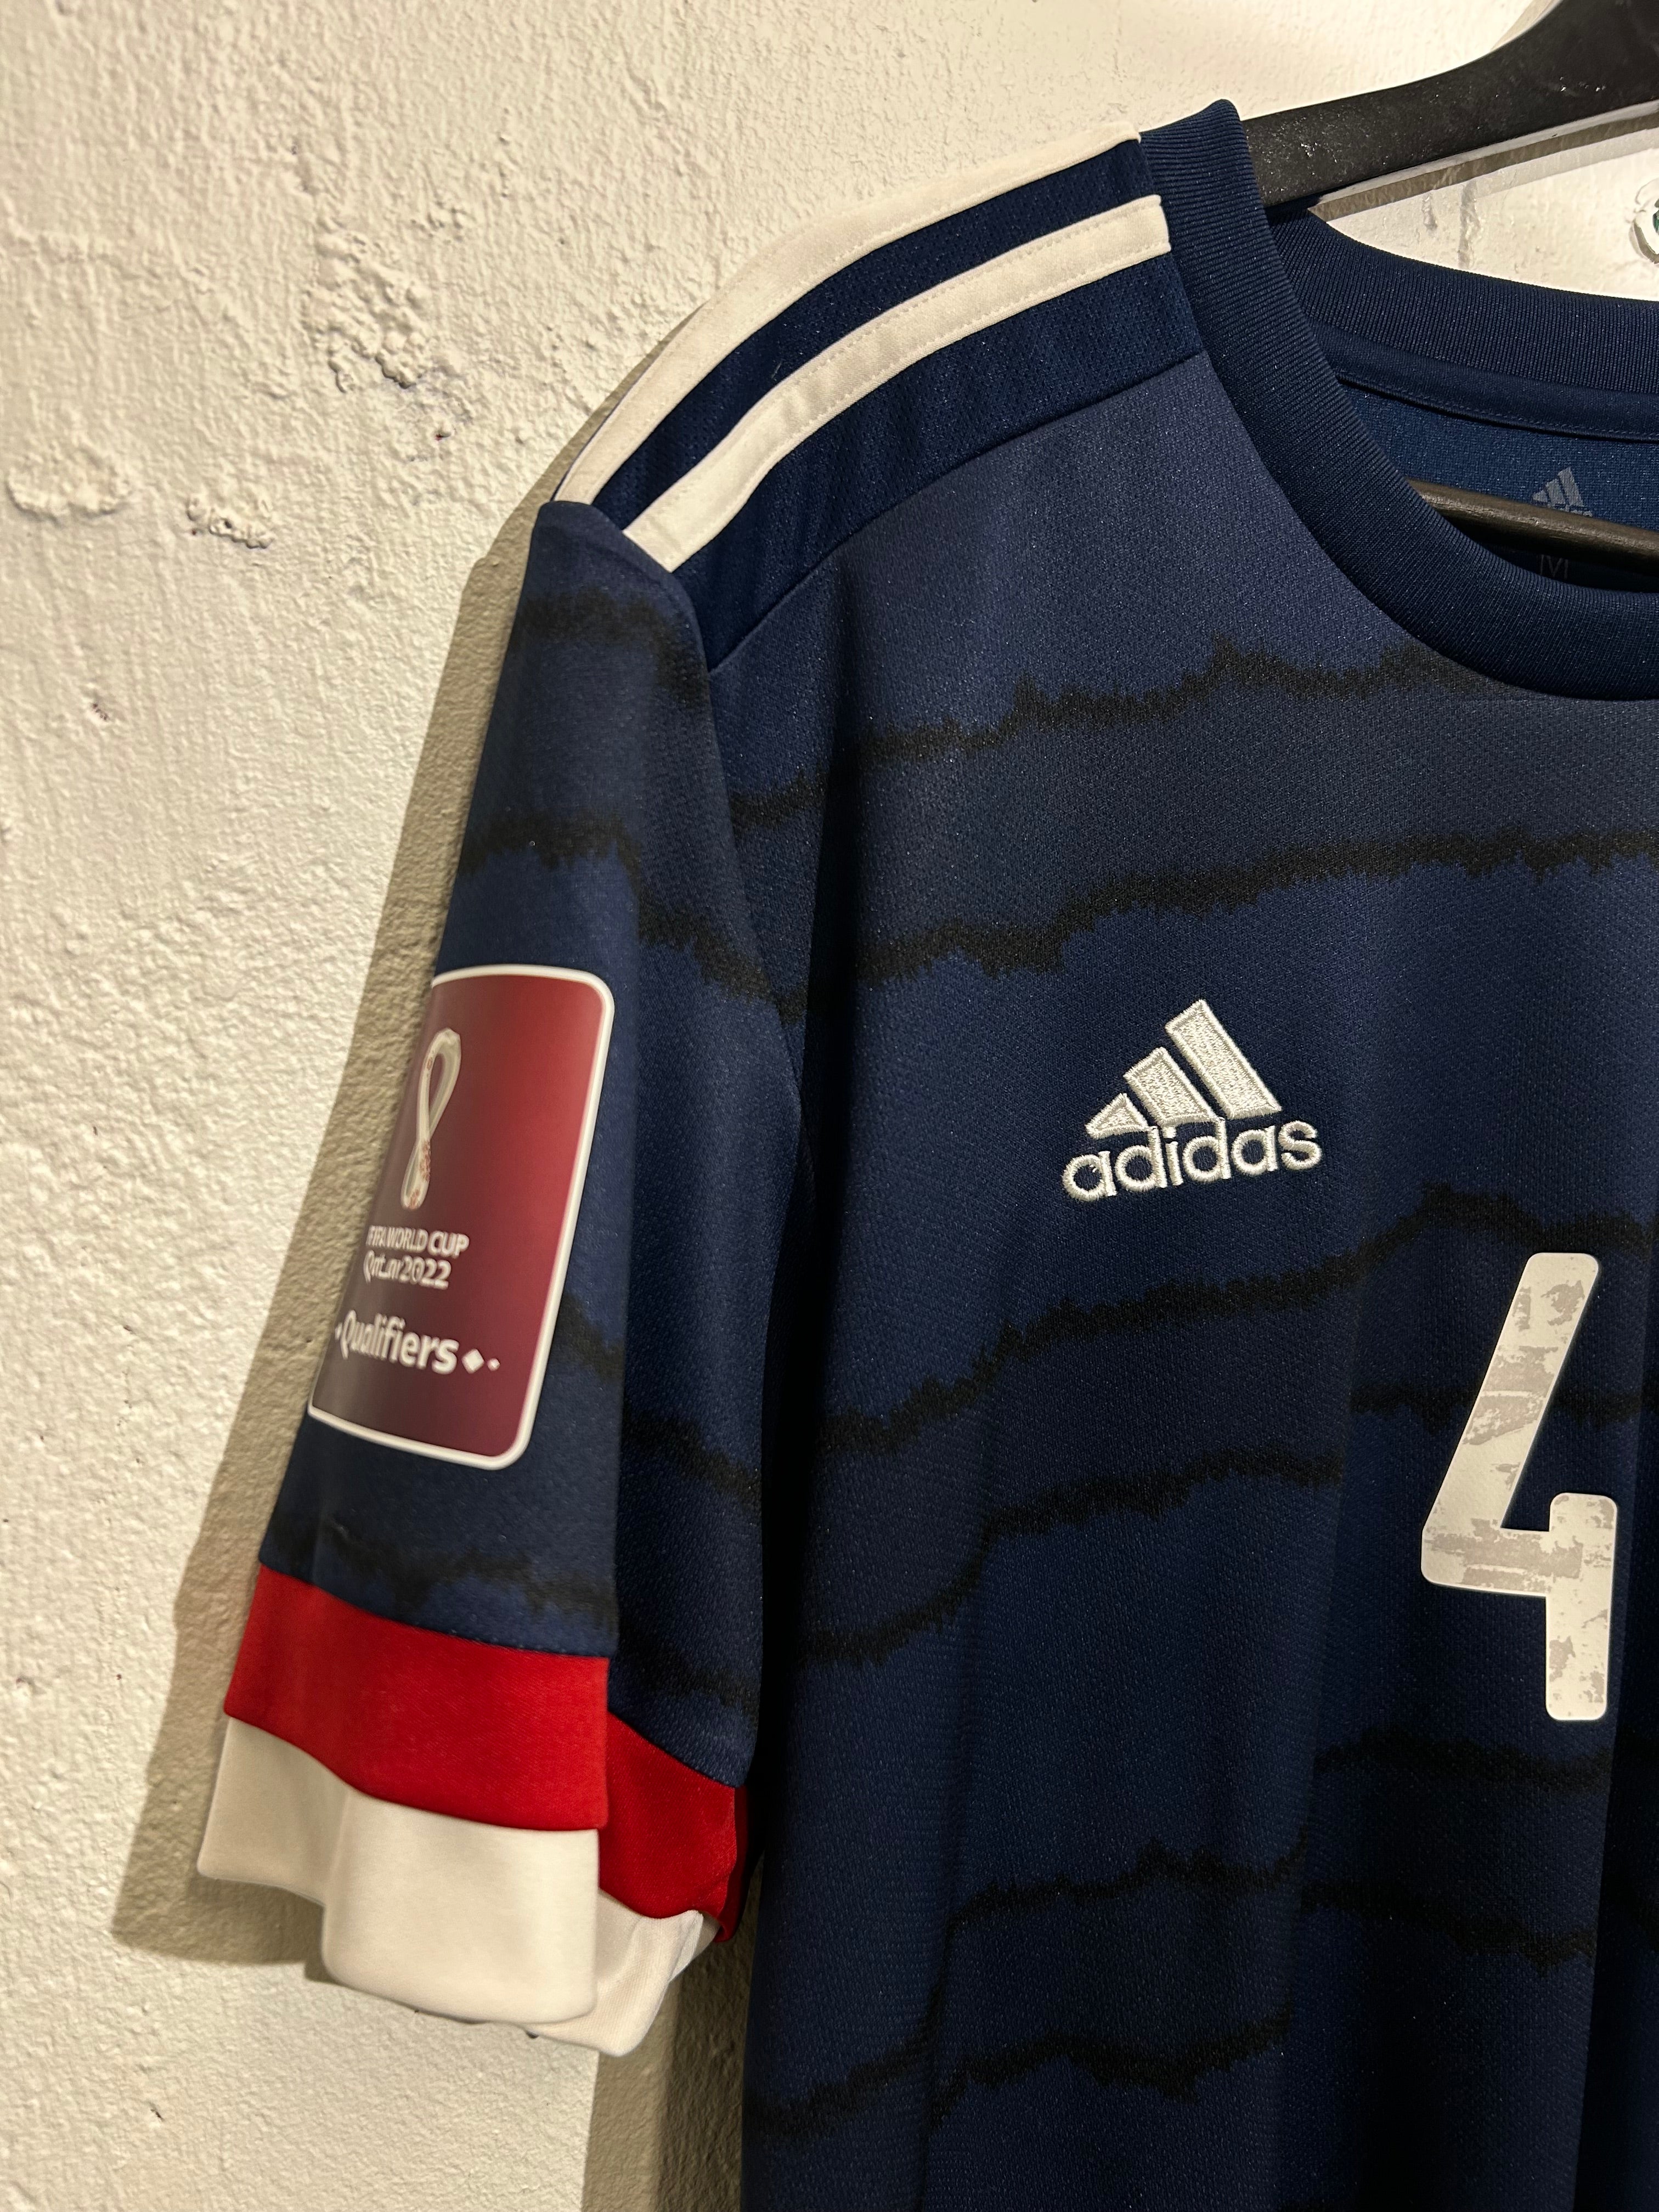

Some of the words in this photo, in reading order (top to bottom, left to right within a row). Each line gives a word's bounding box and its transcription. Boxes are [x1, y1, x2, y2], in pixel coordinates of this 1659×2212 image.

[1062, 1117, 1322, 1201] adidas
[386, 1227, 428, 1253] WORLD
[428, 1231, 470, 1259] CUP
[340, 1310, 460, 1375] Qualifiers
[1421, 1252, 1617, 1720] 4
